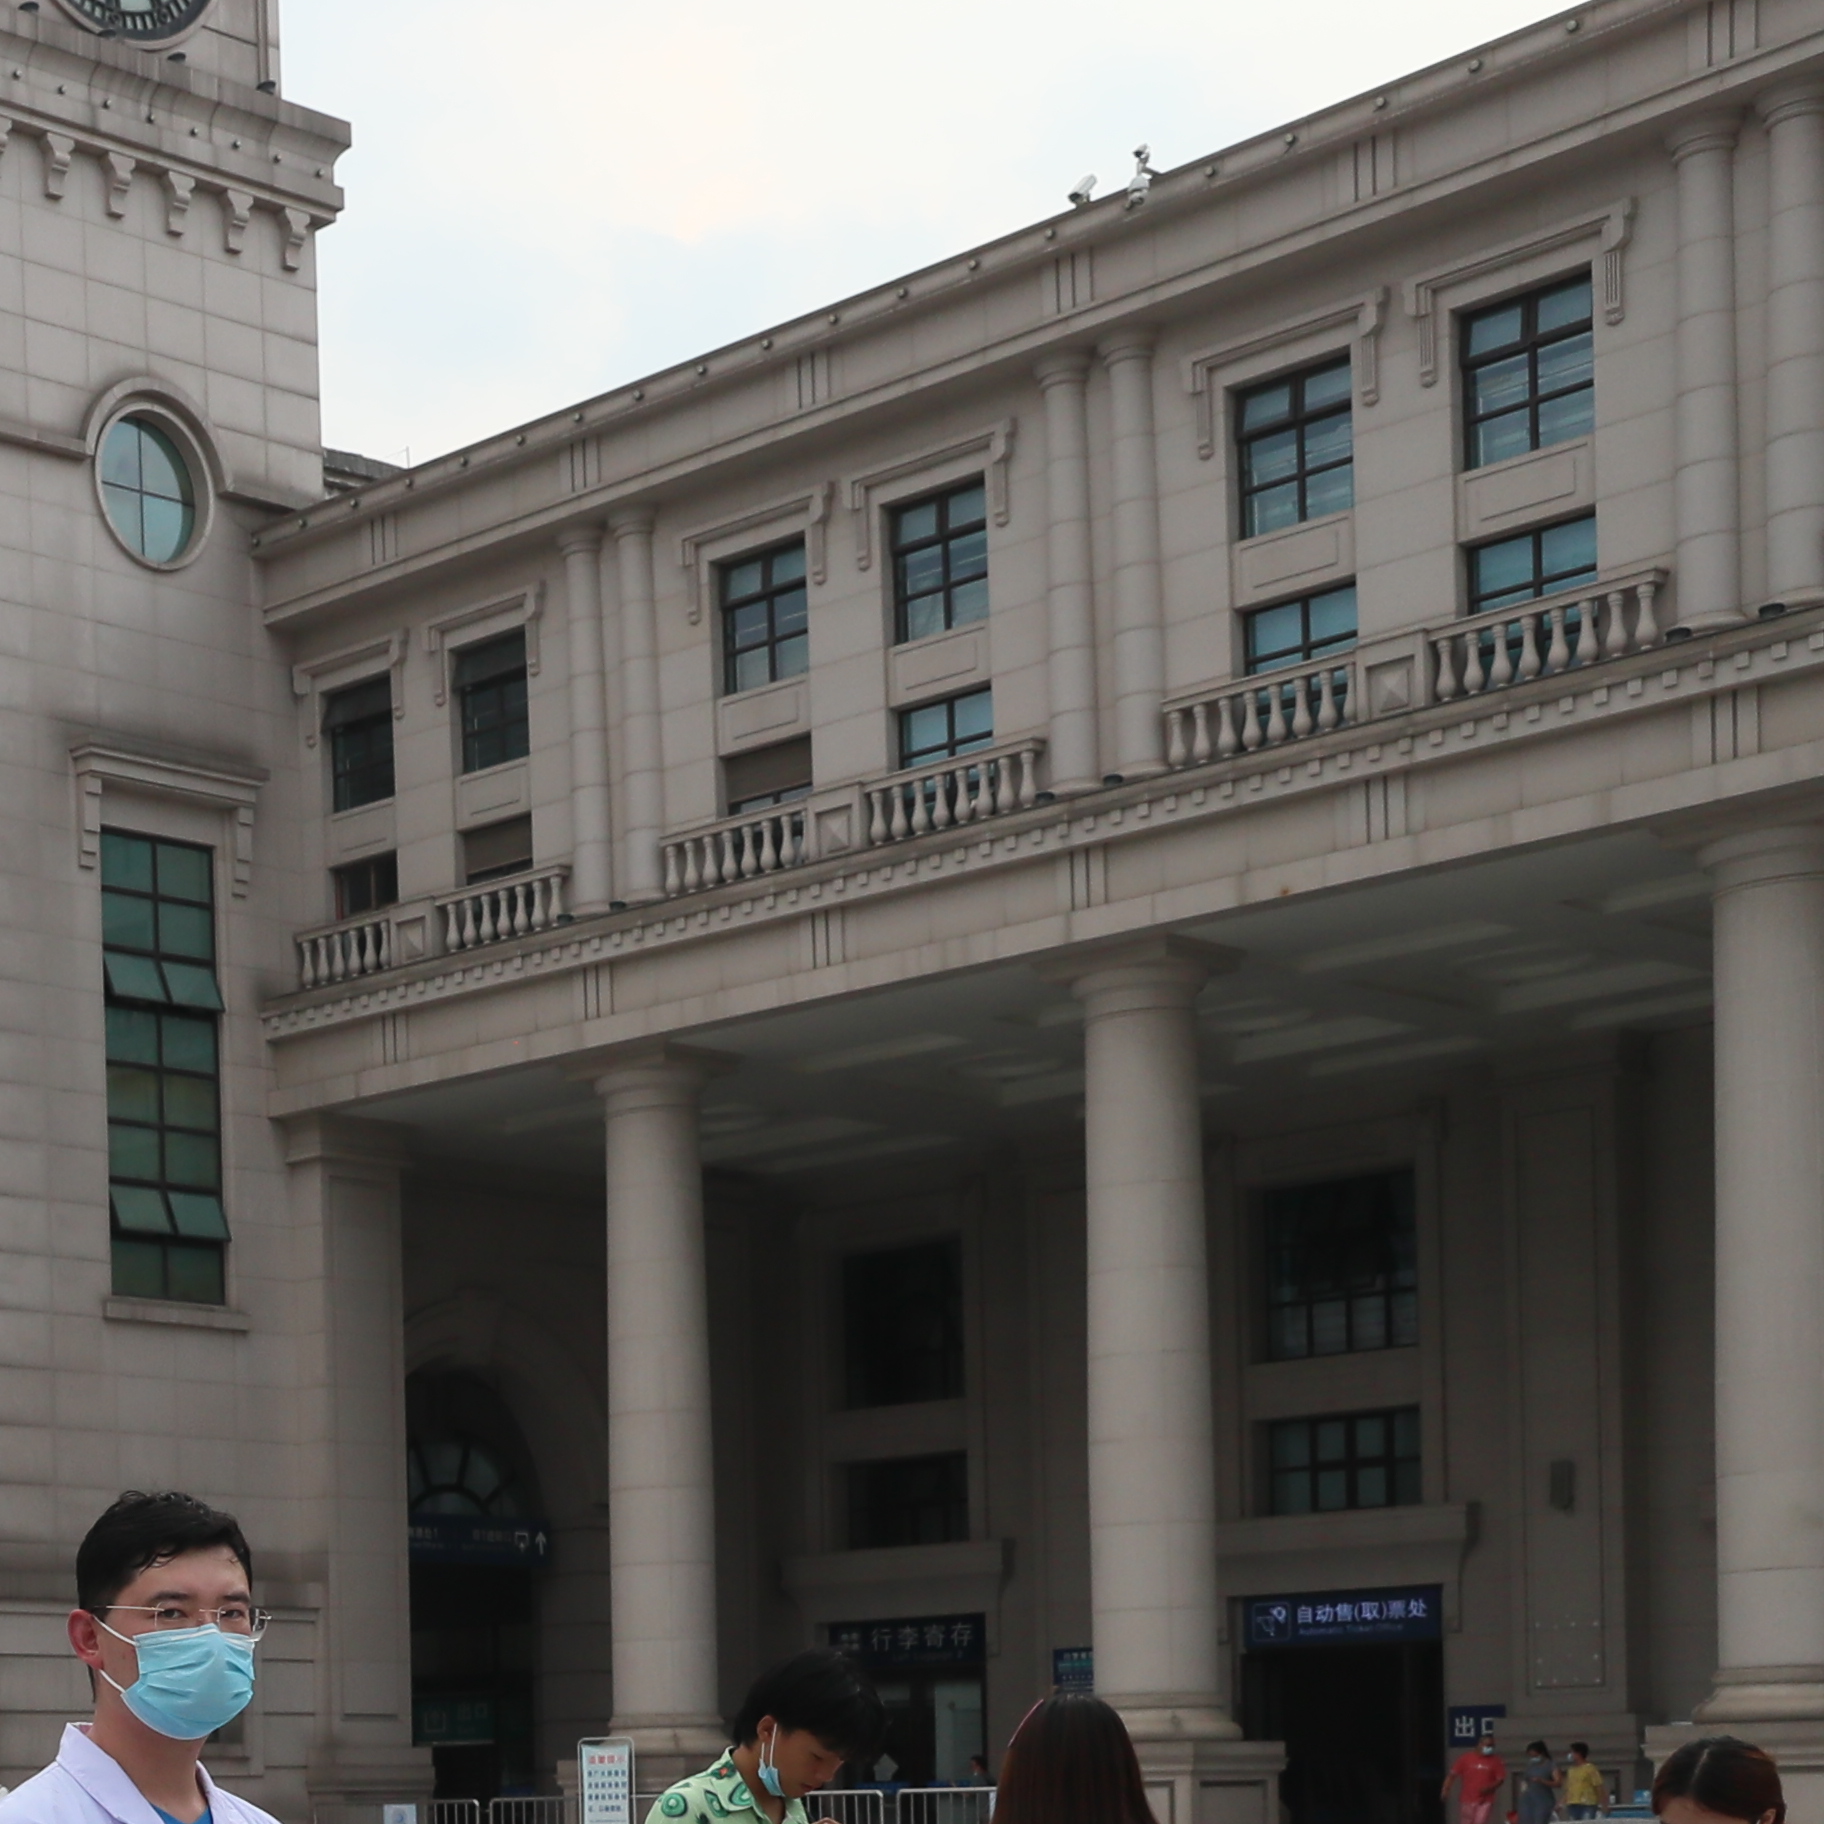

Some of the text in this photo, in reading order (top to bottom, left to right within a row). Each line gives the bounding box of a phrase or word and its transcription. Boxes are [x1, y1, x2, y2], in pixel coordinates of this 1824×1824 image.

[1297, 1598, 1428, 1625] 自动售(取)票处
[871, 1622, 974, 1652] 行李寄存
[1454, 1715, 1494, 1738] 出口
